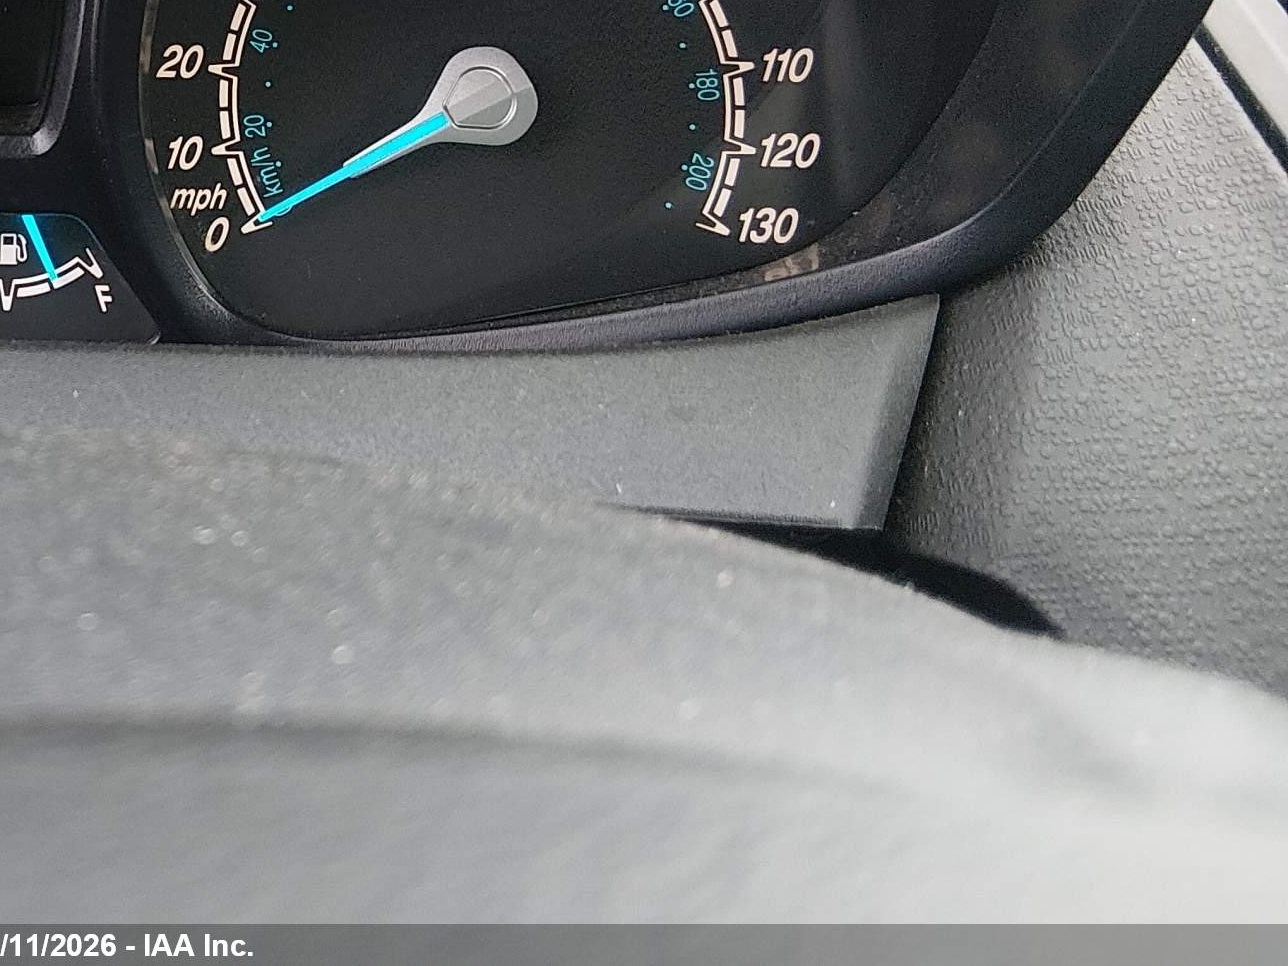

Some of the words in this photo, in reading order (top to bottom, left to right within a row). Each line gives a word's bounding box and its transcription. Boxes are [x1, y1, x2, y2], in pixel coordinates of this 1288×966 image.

[249, 28, 273, 54] 40
[155, 45, 205, 78] 20
[761, 48, 813, 83] 110
[695, 69, 719, 101] 180
[243, 113, 266, 139] 20
[167, 135, 203, 171] 10
[760, 133, 820, 168] 120
[250, 146, 283, 198] km/h
[686, 154, 713, 191] 200
[170, 186, 227, 214] mph
[204, 217, 229, 252] 0
[738, 207, 799, 244] 130
[94, 285, 113, 312] F
